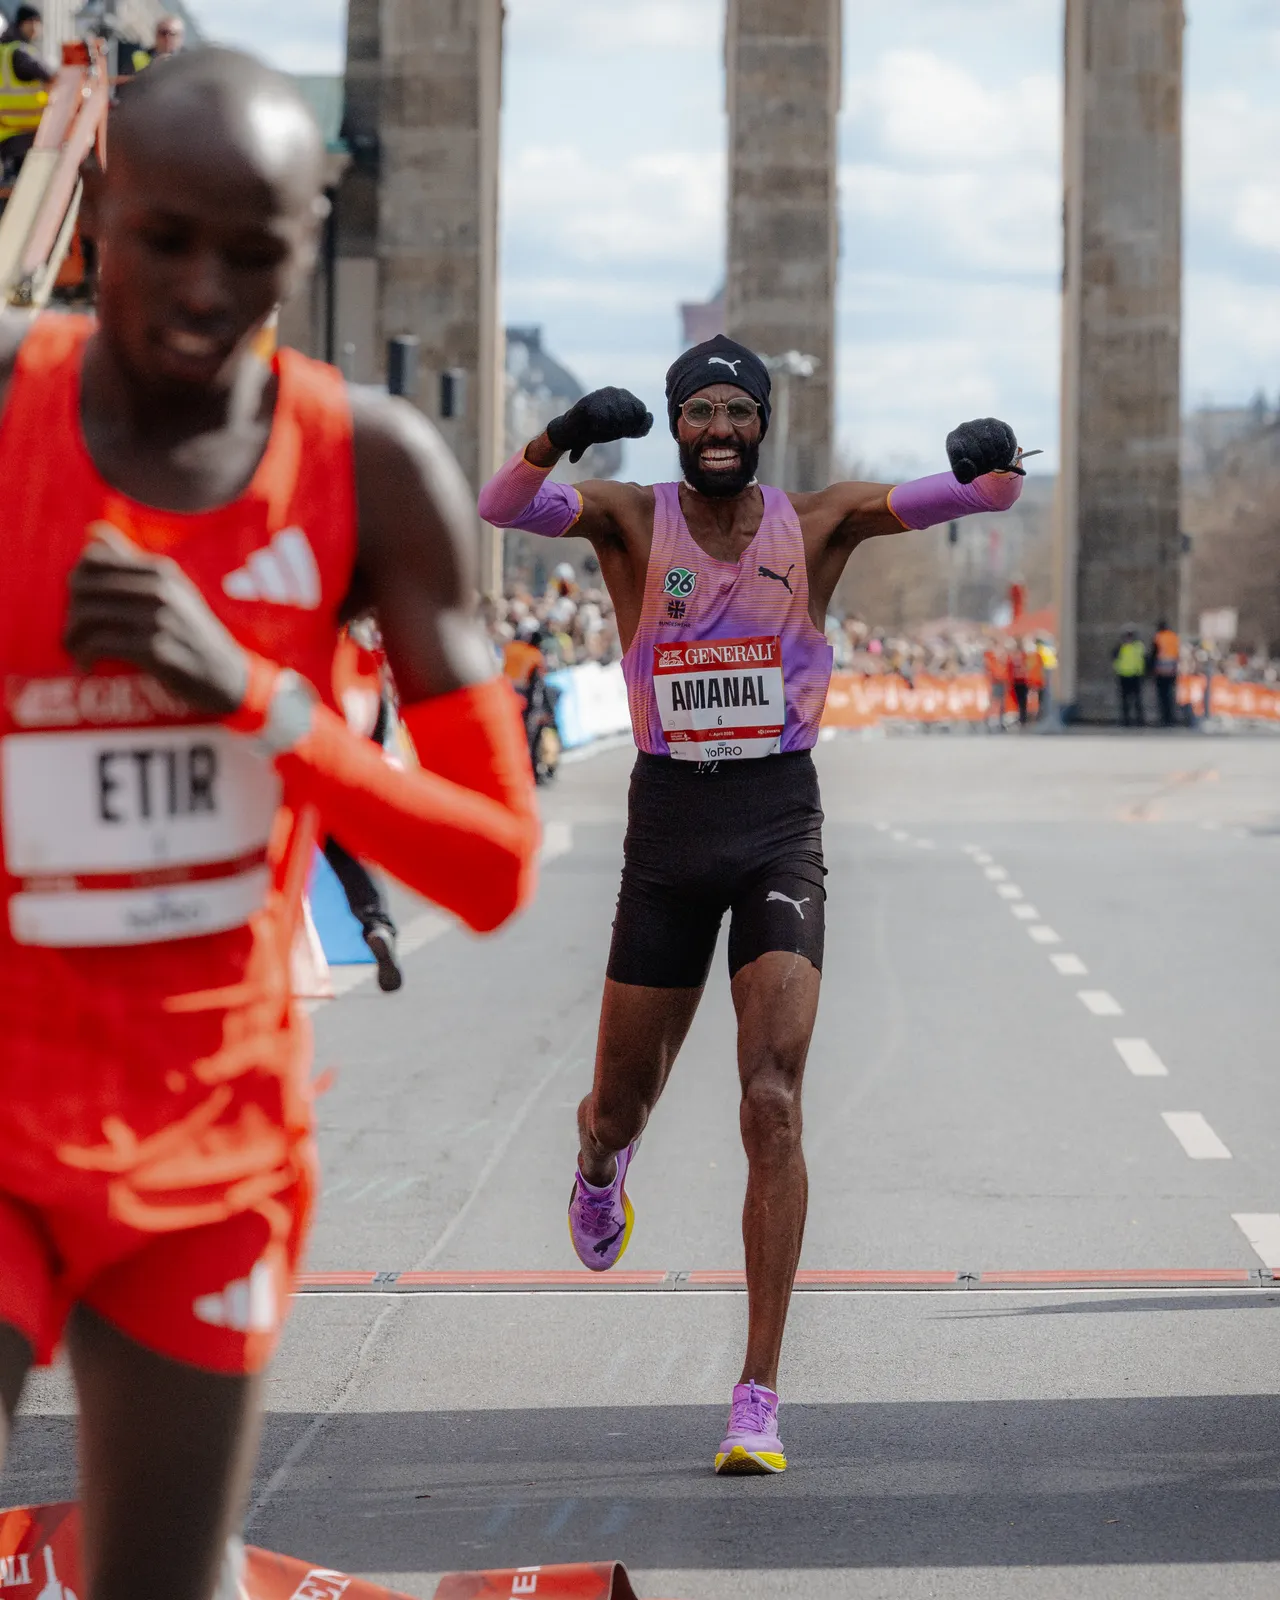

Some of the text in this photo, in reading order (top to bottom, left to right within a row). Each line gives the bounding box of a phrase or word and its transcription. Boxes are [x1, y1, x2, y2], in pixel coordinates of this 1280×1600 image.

[663, 570, 697, 595] 96
[684, 643, 773, 666] GENERALI
[671, 675, 770, 711] AMANAL
[717, 715, 723, 726] 6
[705, 746, 743, 758] YoPRO
[98, 745, 216, 823] ETIR
